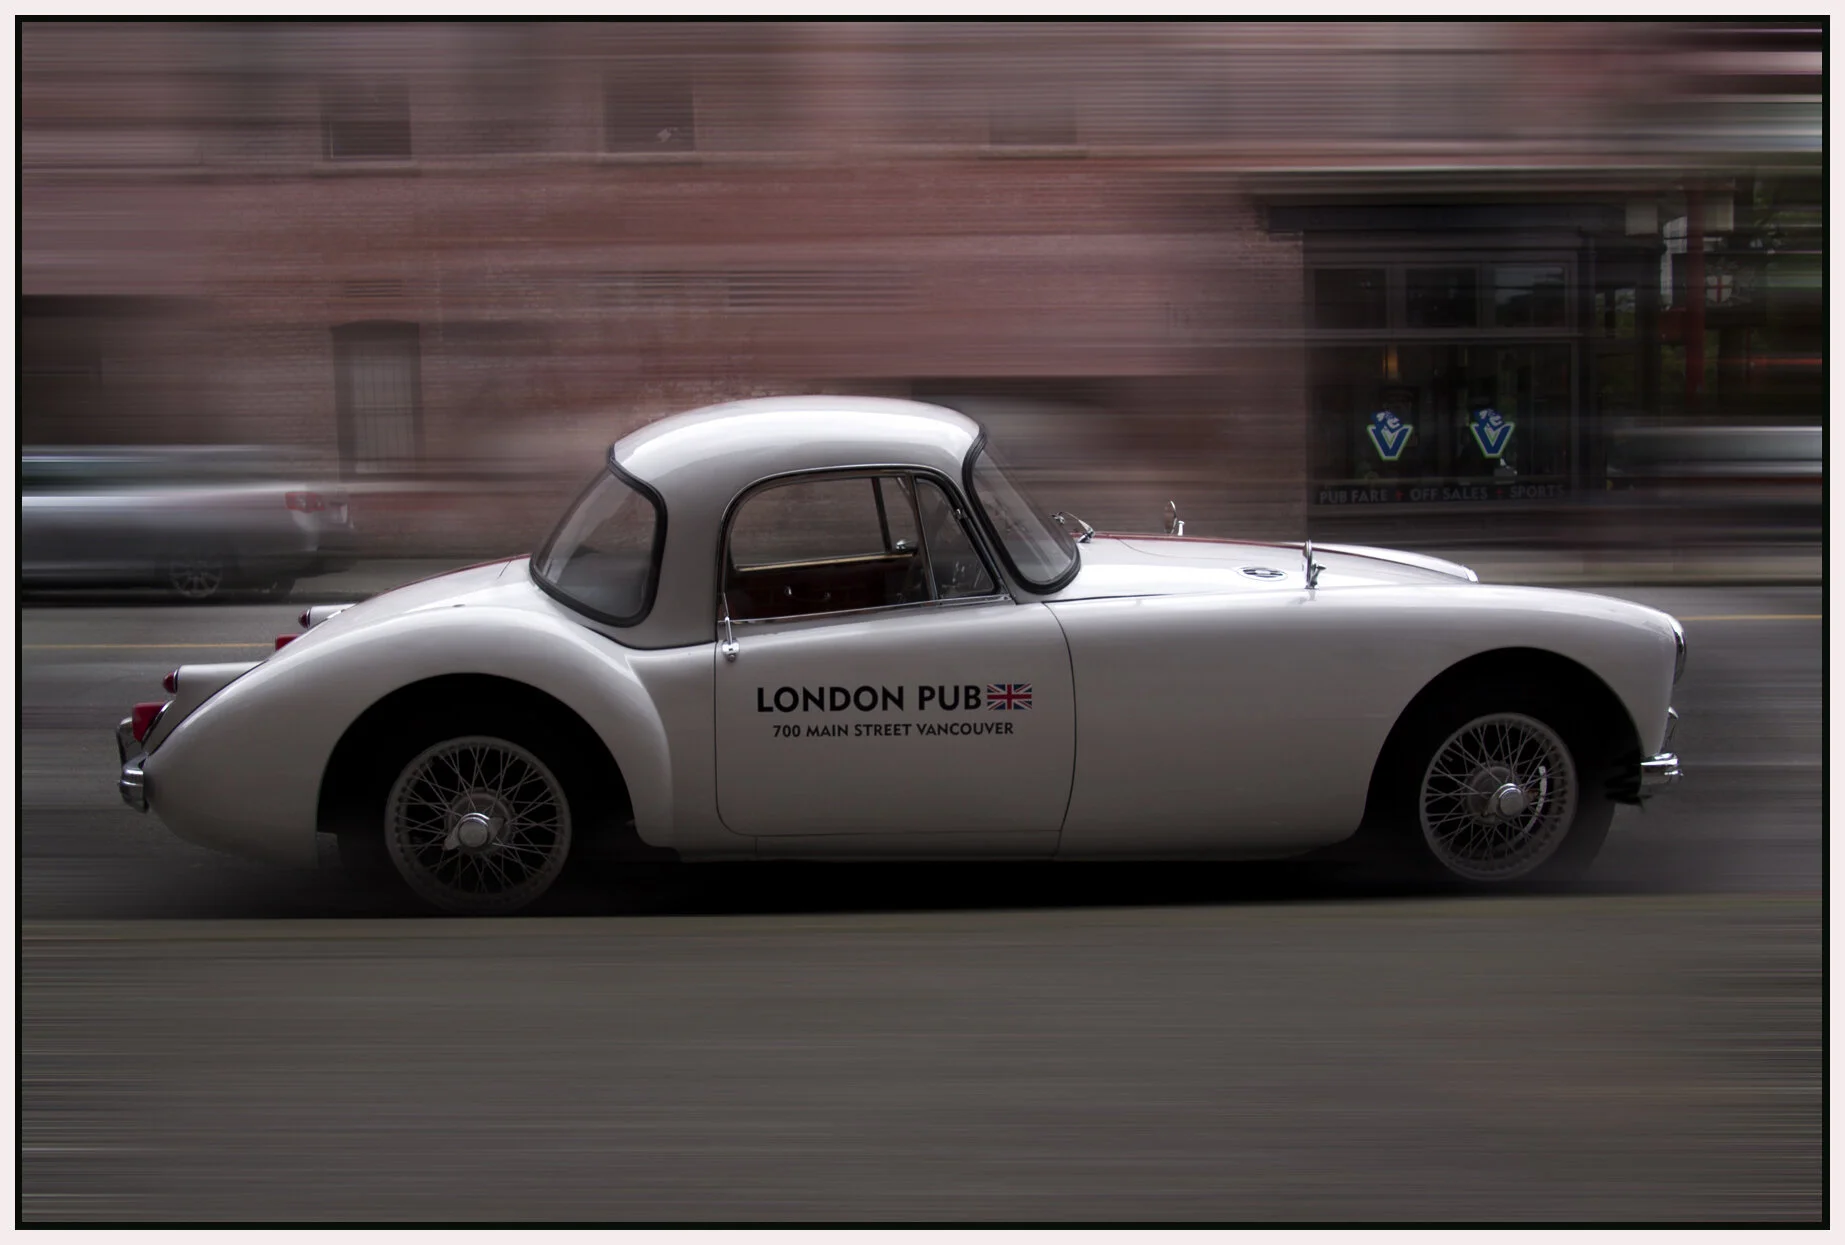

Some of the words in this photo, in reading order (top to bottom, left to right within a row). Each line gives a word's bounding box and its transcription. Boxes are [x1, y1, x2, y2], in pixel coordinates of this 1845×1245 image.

[1319, 490, 1347, 504] PUB
[1351, 489, 1389, 503] FARE
[1410, 488, 1439, 501] OFF
[1443, 486, 1489, 501] SALES
[1509, 484, 1565, 499] SPORTS
[757, 685, 905, 713] LONDON
[918, 684, 983, 711] PUB
[773, 724, 800, 738] 700
[806, 723, 849, 738] MAIN
[854, 723, 912, 737] STREET
[916, 722, 1015, 736] VANCOUVER
